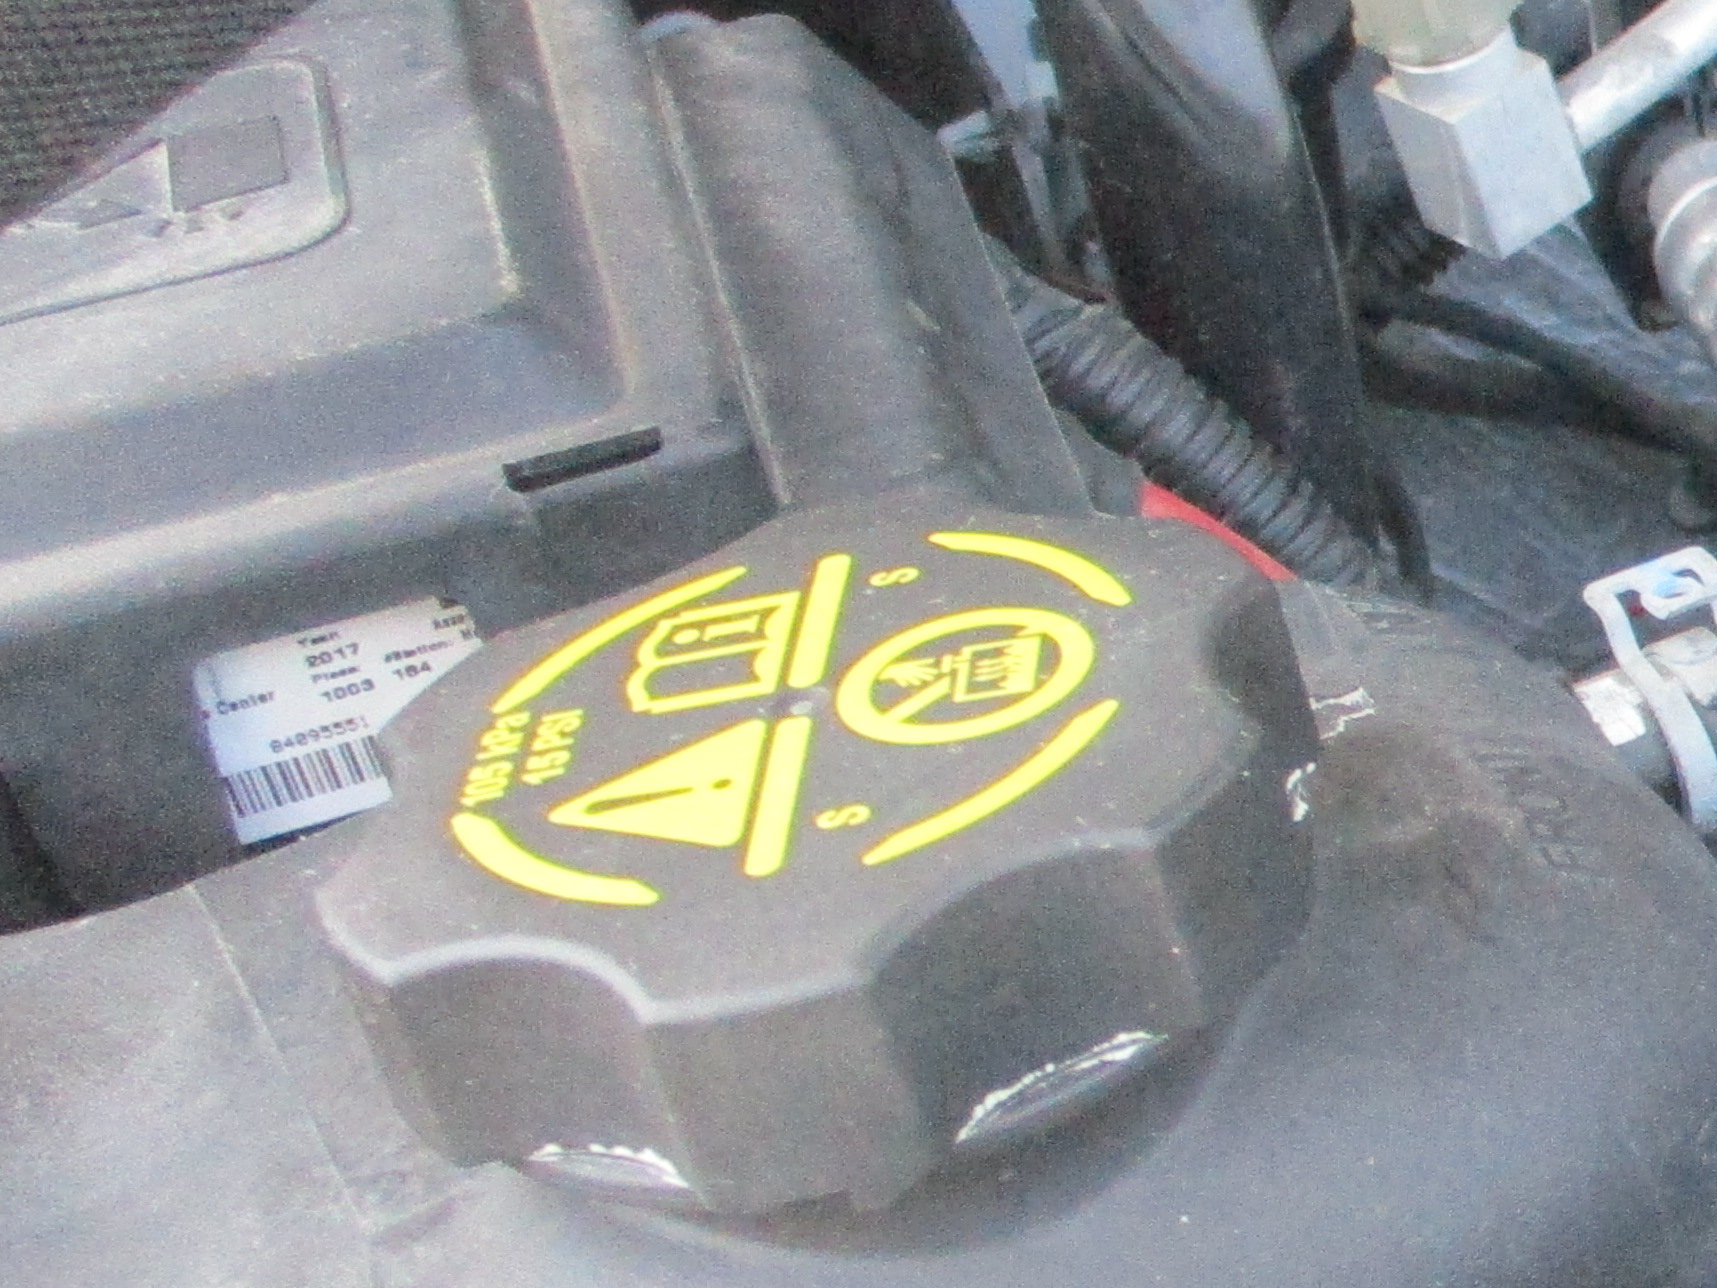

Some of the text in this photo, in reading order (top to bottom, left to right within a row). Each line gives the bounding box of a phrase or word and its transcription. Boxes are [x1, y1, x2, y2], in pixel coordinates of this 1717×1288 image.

[305, 642, 359, 667] 2017
[320, 678, 375, 703] 1003
[460, 710, 531, 807] 105 kPa
[521, 708, 584, 786] 15 PSI
